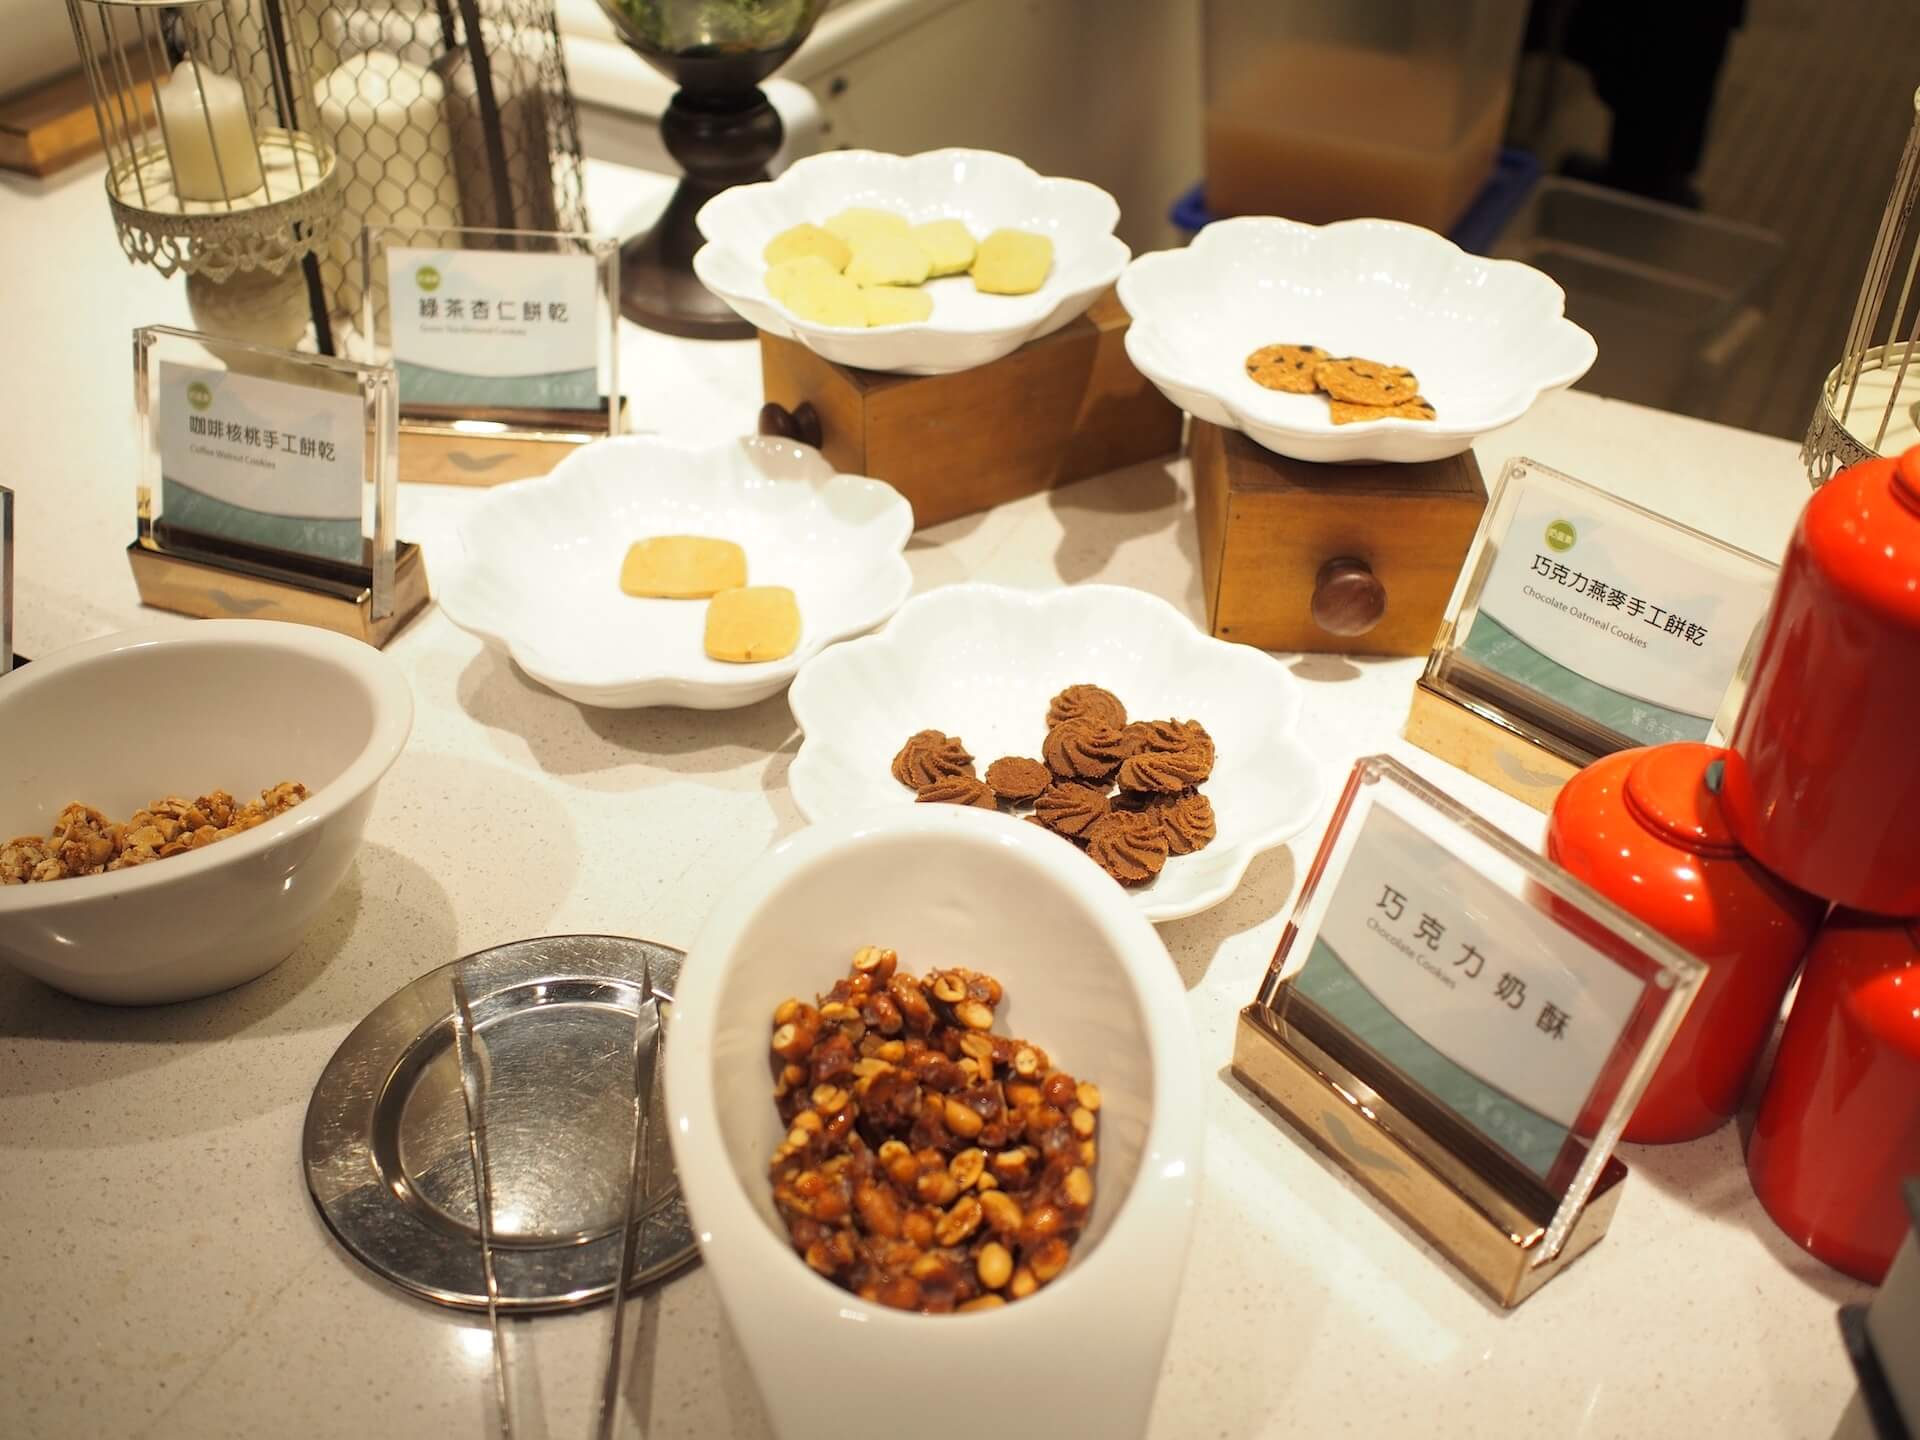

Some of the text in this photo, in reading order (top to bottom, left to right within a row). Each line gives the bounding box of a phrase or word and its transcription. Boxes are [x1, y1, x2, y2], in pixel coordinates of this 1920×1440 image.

[418, 298, 569, 323] 綠茶杏仁餅乾
[189, 415, 336, 462] 咖啡核桃手工餅乾
[1522, 585, 1648, 649] Chocolate Oatmeal Cookies
[1531, 554, 1708, 647] 巧克力燕麥手工餅乾
[1366, 917, 1456, 990] Chocolate Cookies
[1376, 884, 1573, 1041] 巧克力奶酥
